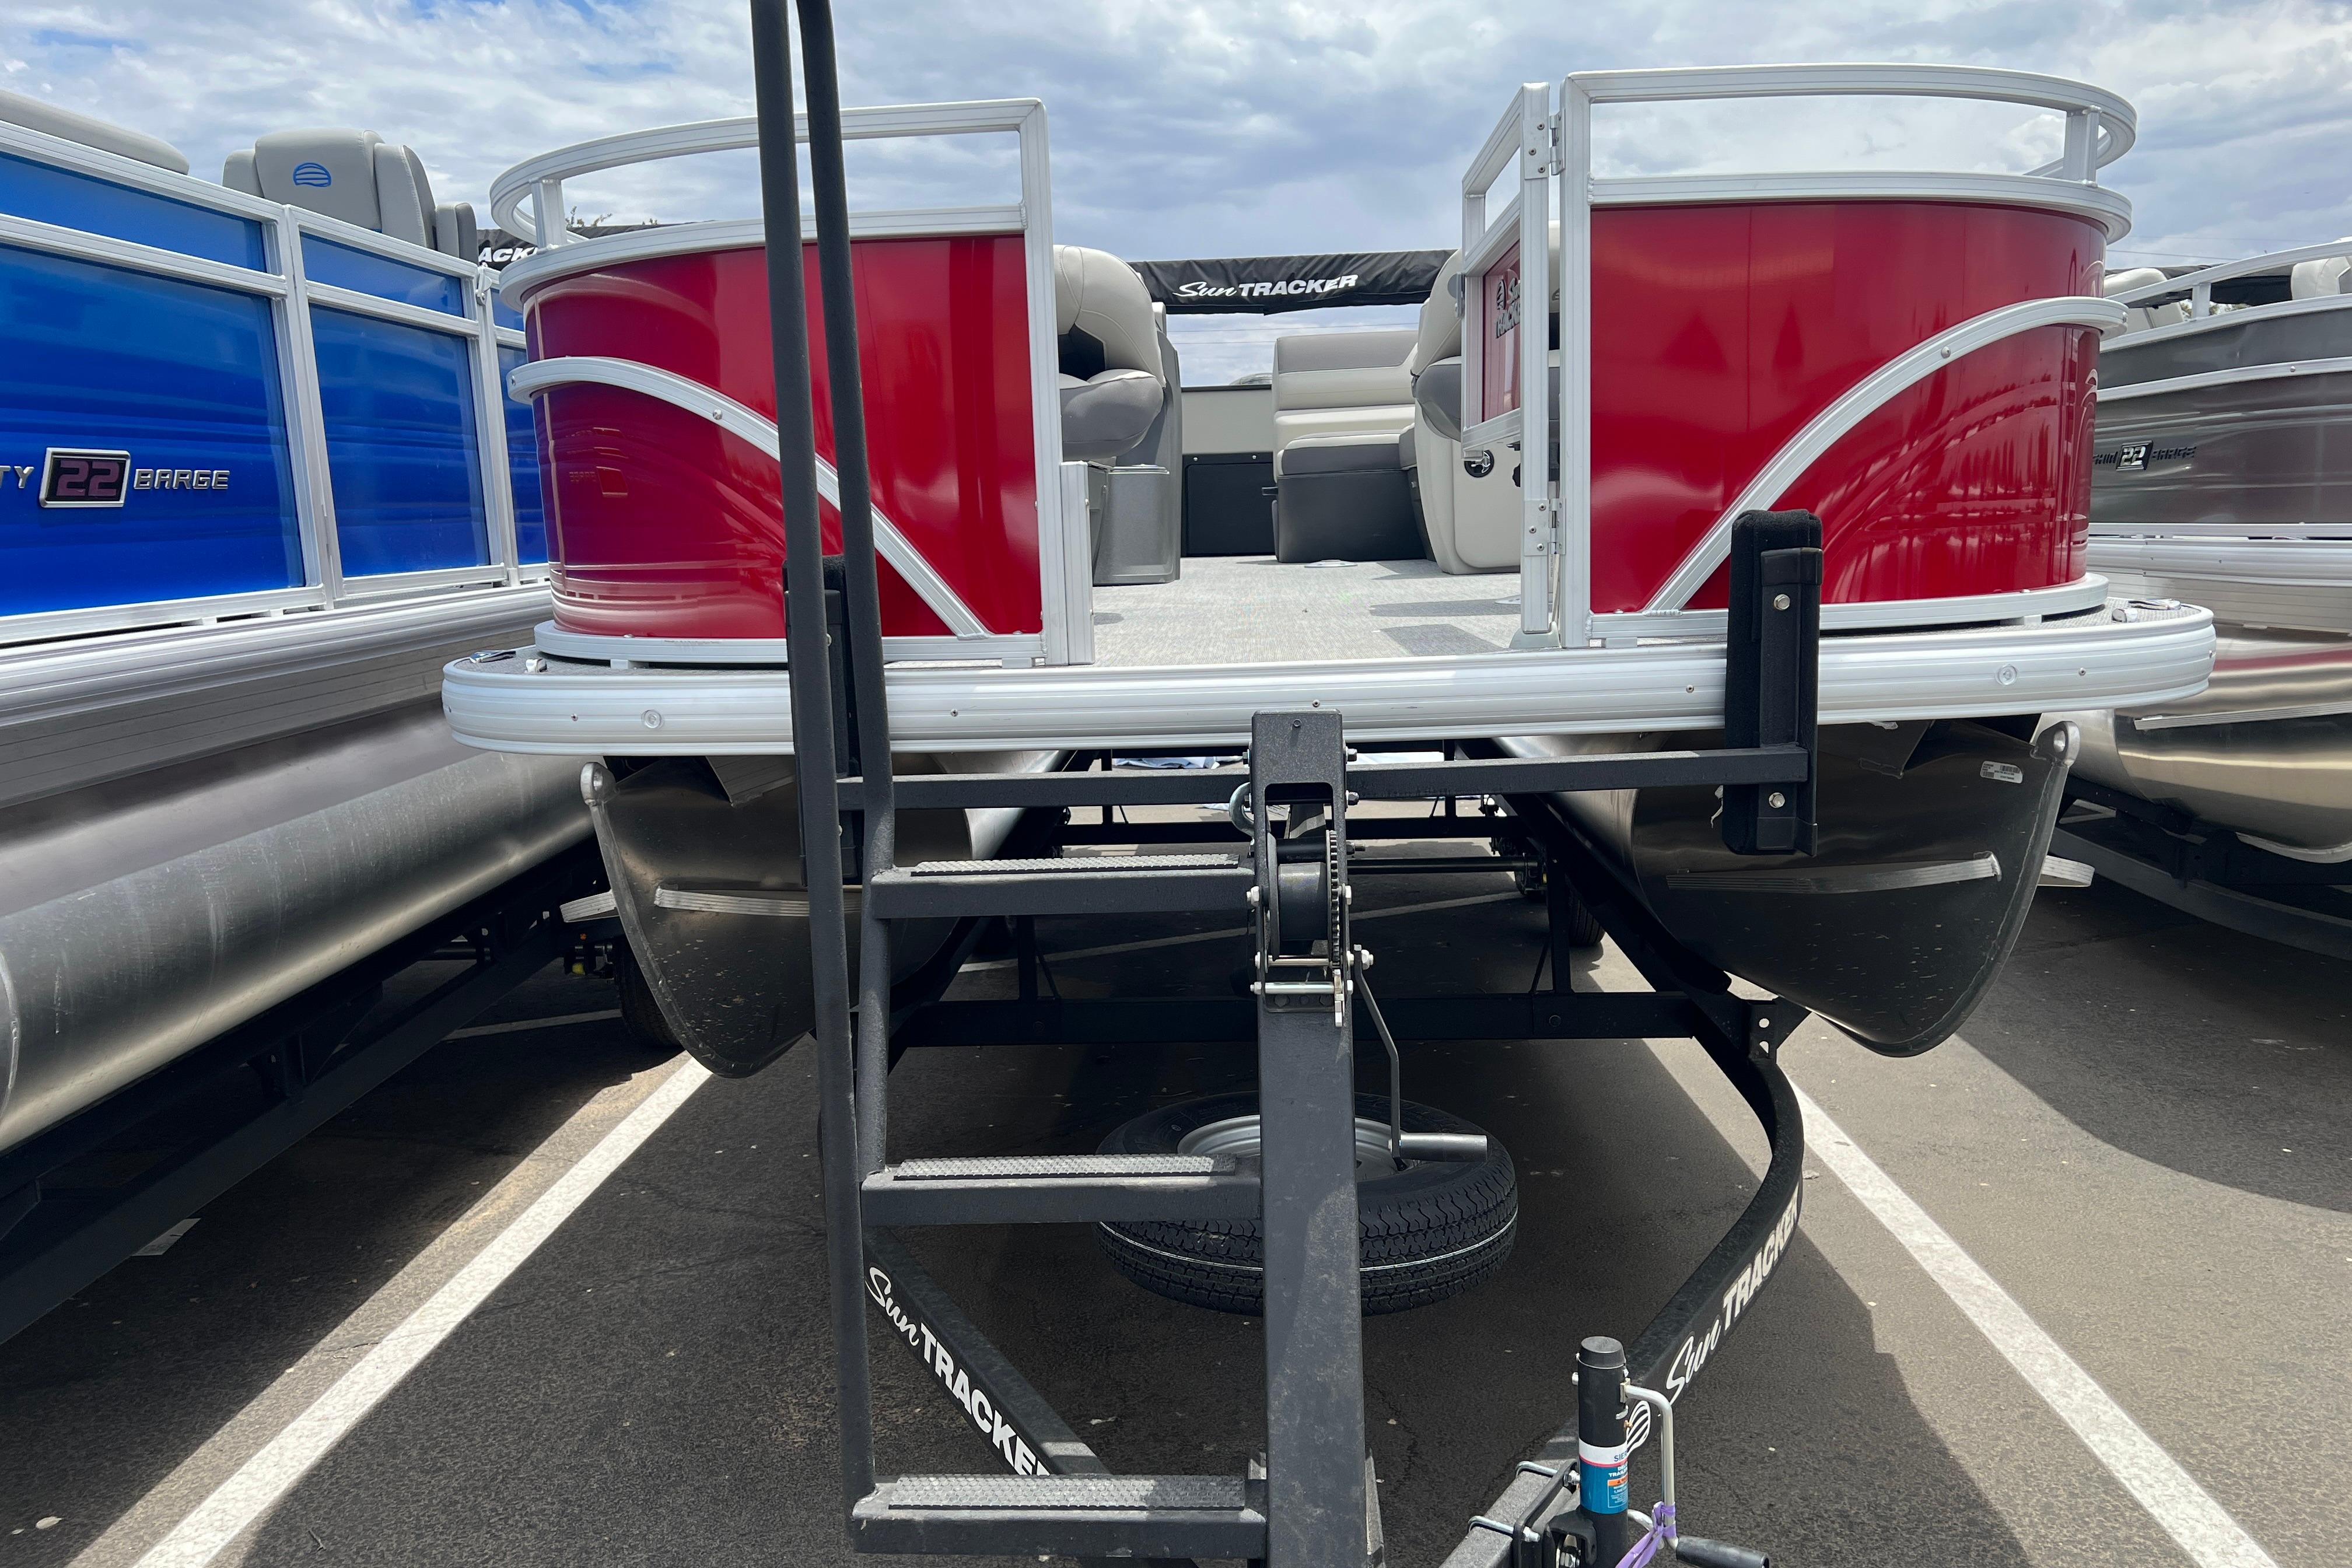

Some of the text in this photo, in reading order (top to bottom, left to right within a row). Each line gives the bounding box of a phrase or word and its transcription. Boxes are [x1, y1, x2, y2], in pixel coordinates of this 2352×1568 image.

[478, 247, 538, 262] ACK
[1172, 274, 1359, 297] Sun TRACKER
[2120, 446, 2146, 467] 22
[56, 460, 120, 496] 22
[134, 468, 230, 489] BARGE
[864, 1266, 919, 1346] Sun
